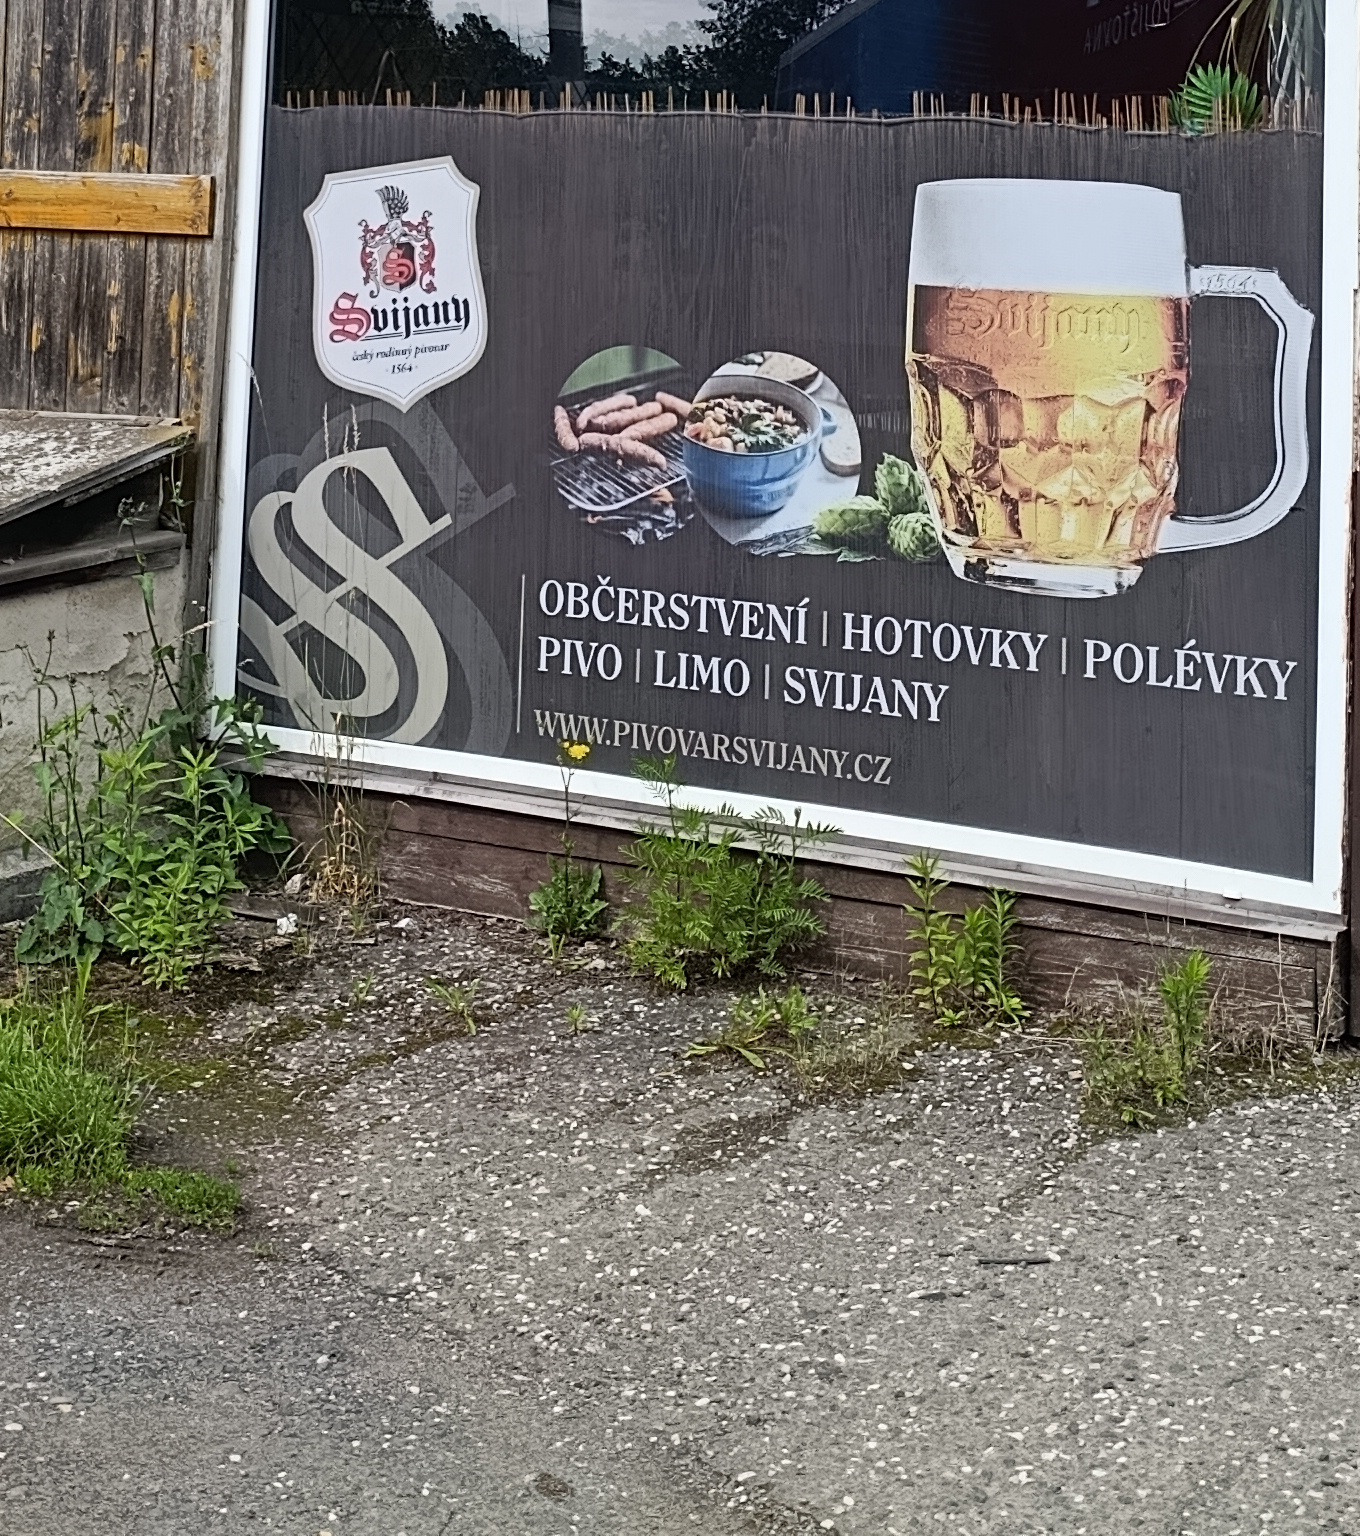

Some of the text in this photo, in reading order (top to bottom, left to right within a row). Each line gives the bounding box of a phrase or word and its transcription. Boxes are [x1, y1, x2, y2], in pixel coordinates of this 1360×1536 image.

[329, 292, 471, 343] Svijany
[945, 286, 1140, 354] Svijany
[391, 362, 414, 375] 1564
[539, 574, 1298, 702] OBČERSTVENÍ HOTOVKY POLÉVKY
[537, 636, 950, 723] PIVO LIMO SVIJANY
[533, 708, 893, 786] WWW.PIVOVARSVIJANY.CZ
